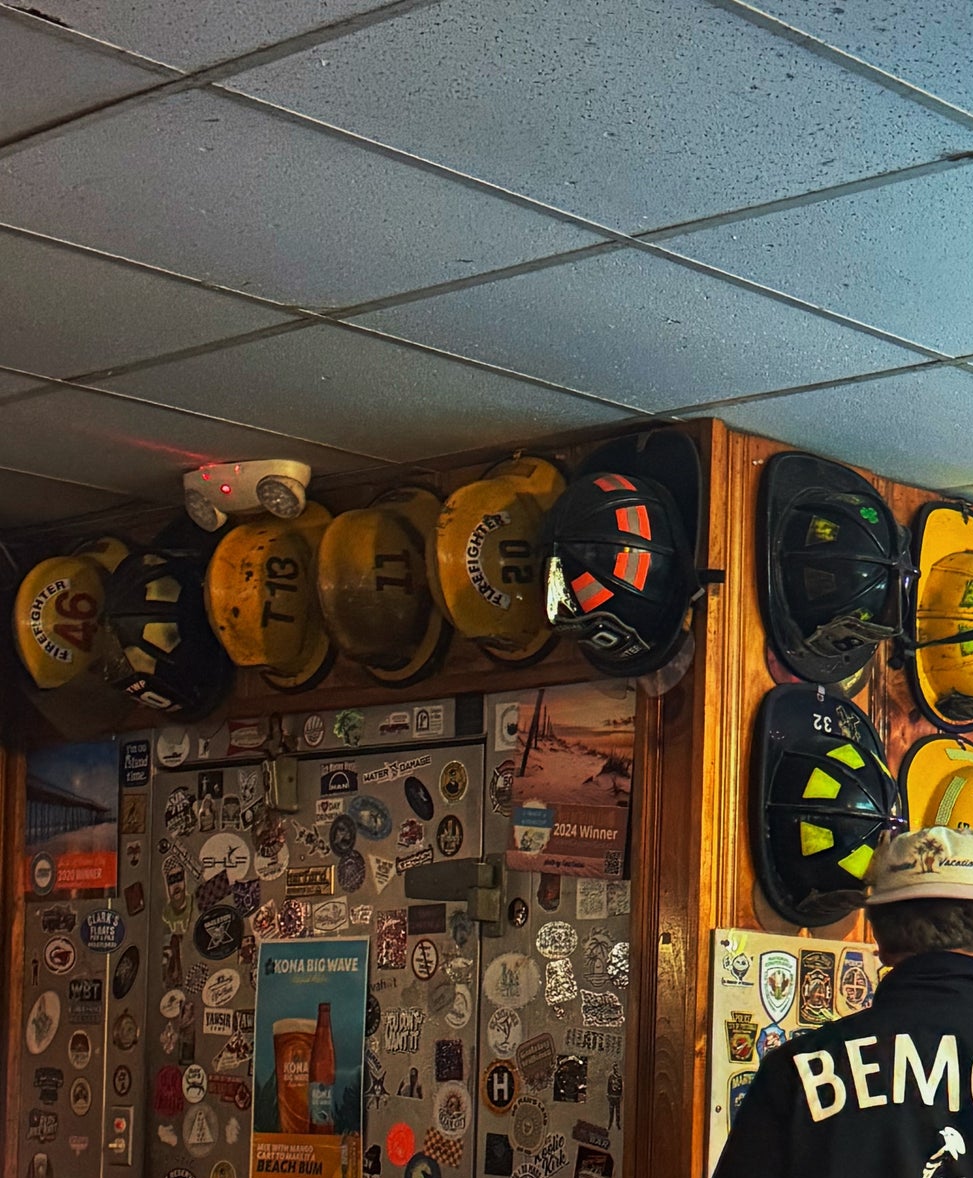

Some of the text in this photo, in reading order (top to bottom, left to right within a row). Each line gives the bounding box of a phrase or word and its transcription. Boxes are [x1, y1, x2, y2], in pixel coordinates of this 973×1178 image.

[498, 539, 534, 585] 20
[31, 579, 70, 661] FIREFIGHTER
[53, 592, 98, 652] 46
[126, 679, 147, 694] TWP
[812, 713, 833, 734] 32
[399, 756, 431, 772] DAMAGE
[553, 822, 619, 841] 2024 Winner
[87, 912, 120, 927] CLARK'S
[90, 926, 116, 936] FLOATS
[274, 957, 358, 974] KONA BIG WAVE
[283, 1062, 309, 1073] KONA
[492, 1072, 509, 1102] H
[289, 1145, 314, 1153] MANGO
[588, 1136, 610, 1150] BAR
[256, 1160, 323, 1175] BEACH BUM
